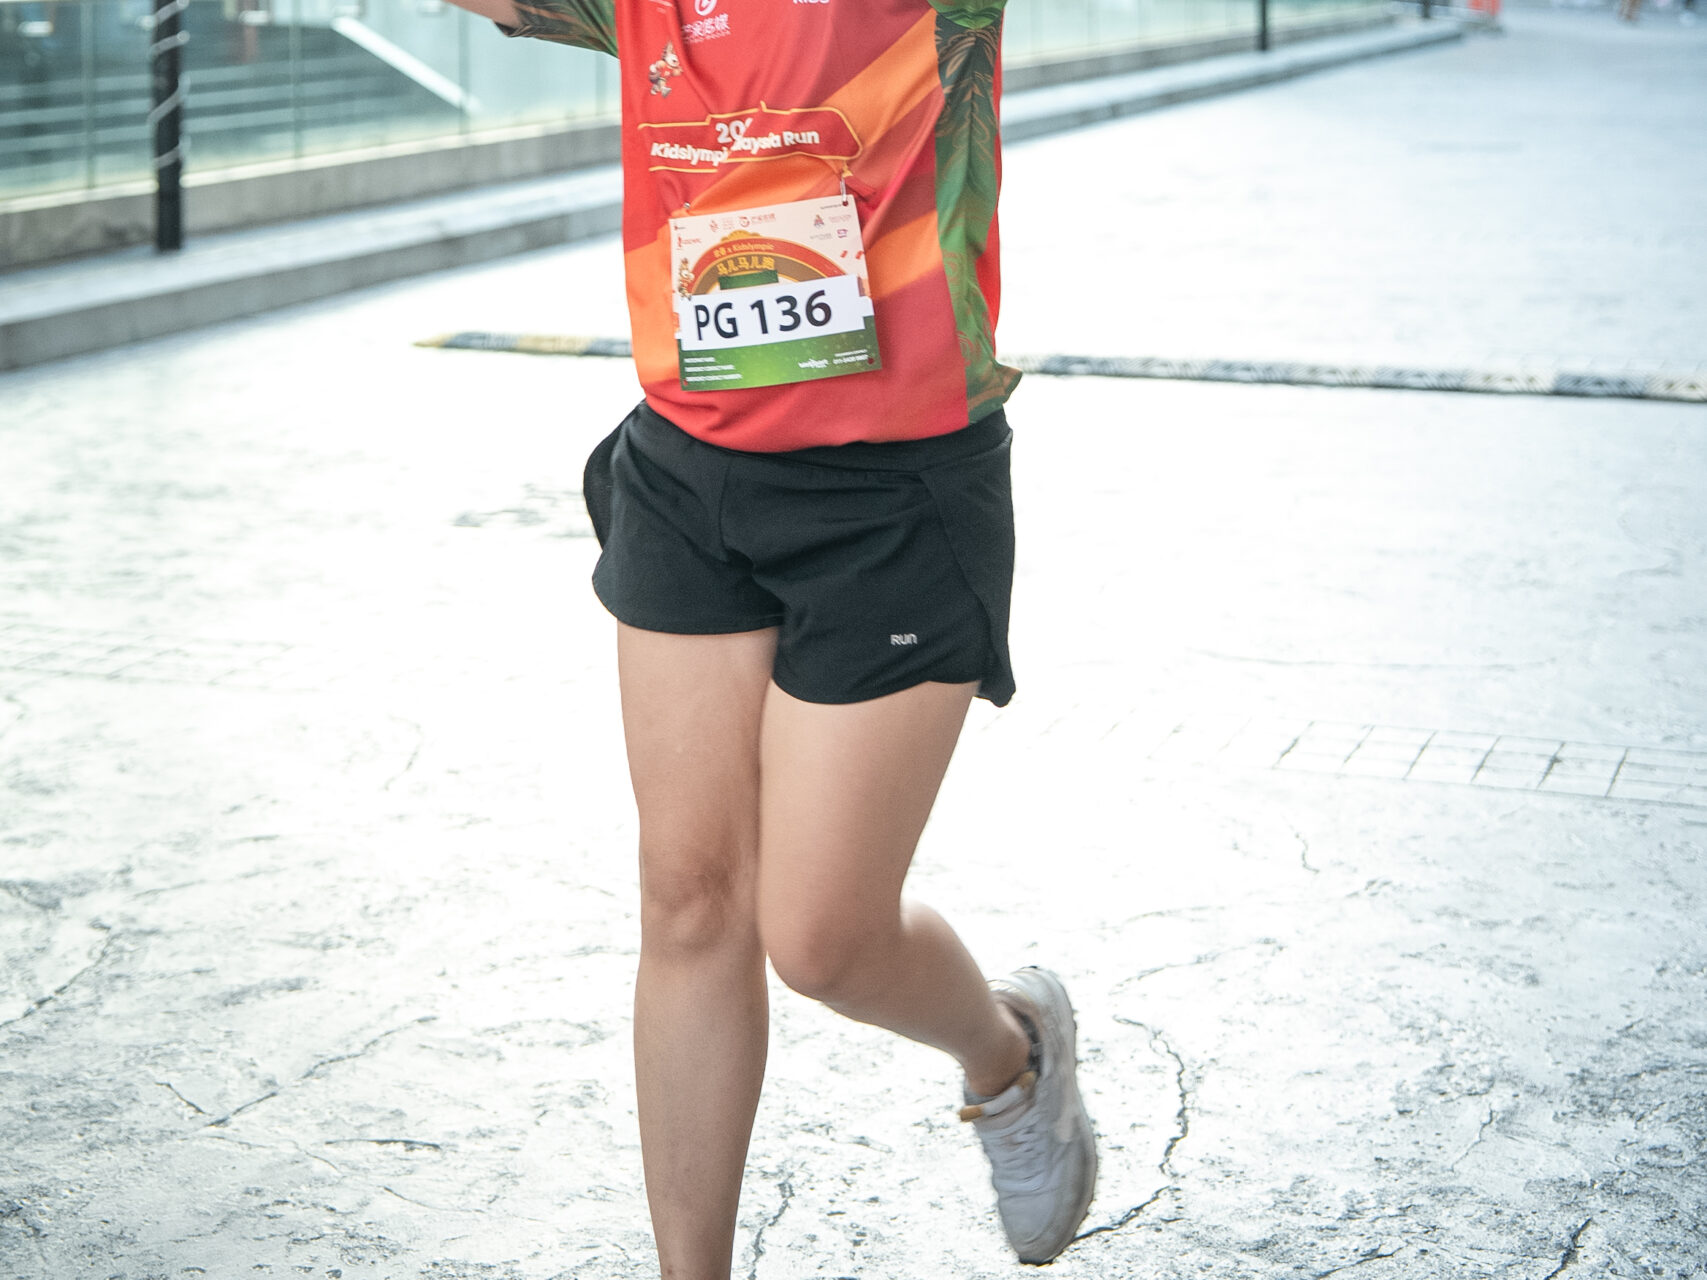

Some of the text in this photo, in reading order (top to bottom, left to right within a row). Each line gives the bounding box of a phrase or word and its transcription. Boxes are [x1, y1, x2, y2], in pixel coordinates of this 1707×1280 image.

[651, 142, 728, 166] Kidslympi
[782, 129, 820, 148] Run
[694, 289, 833, 341] PG 136
